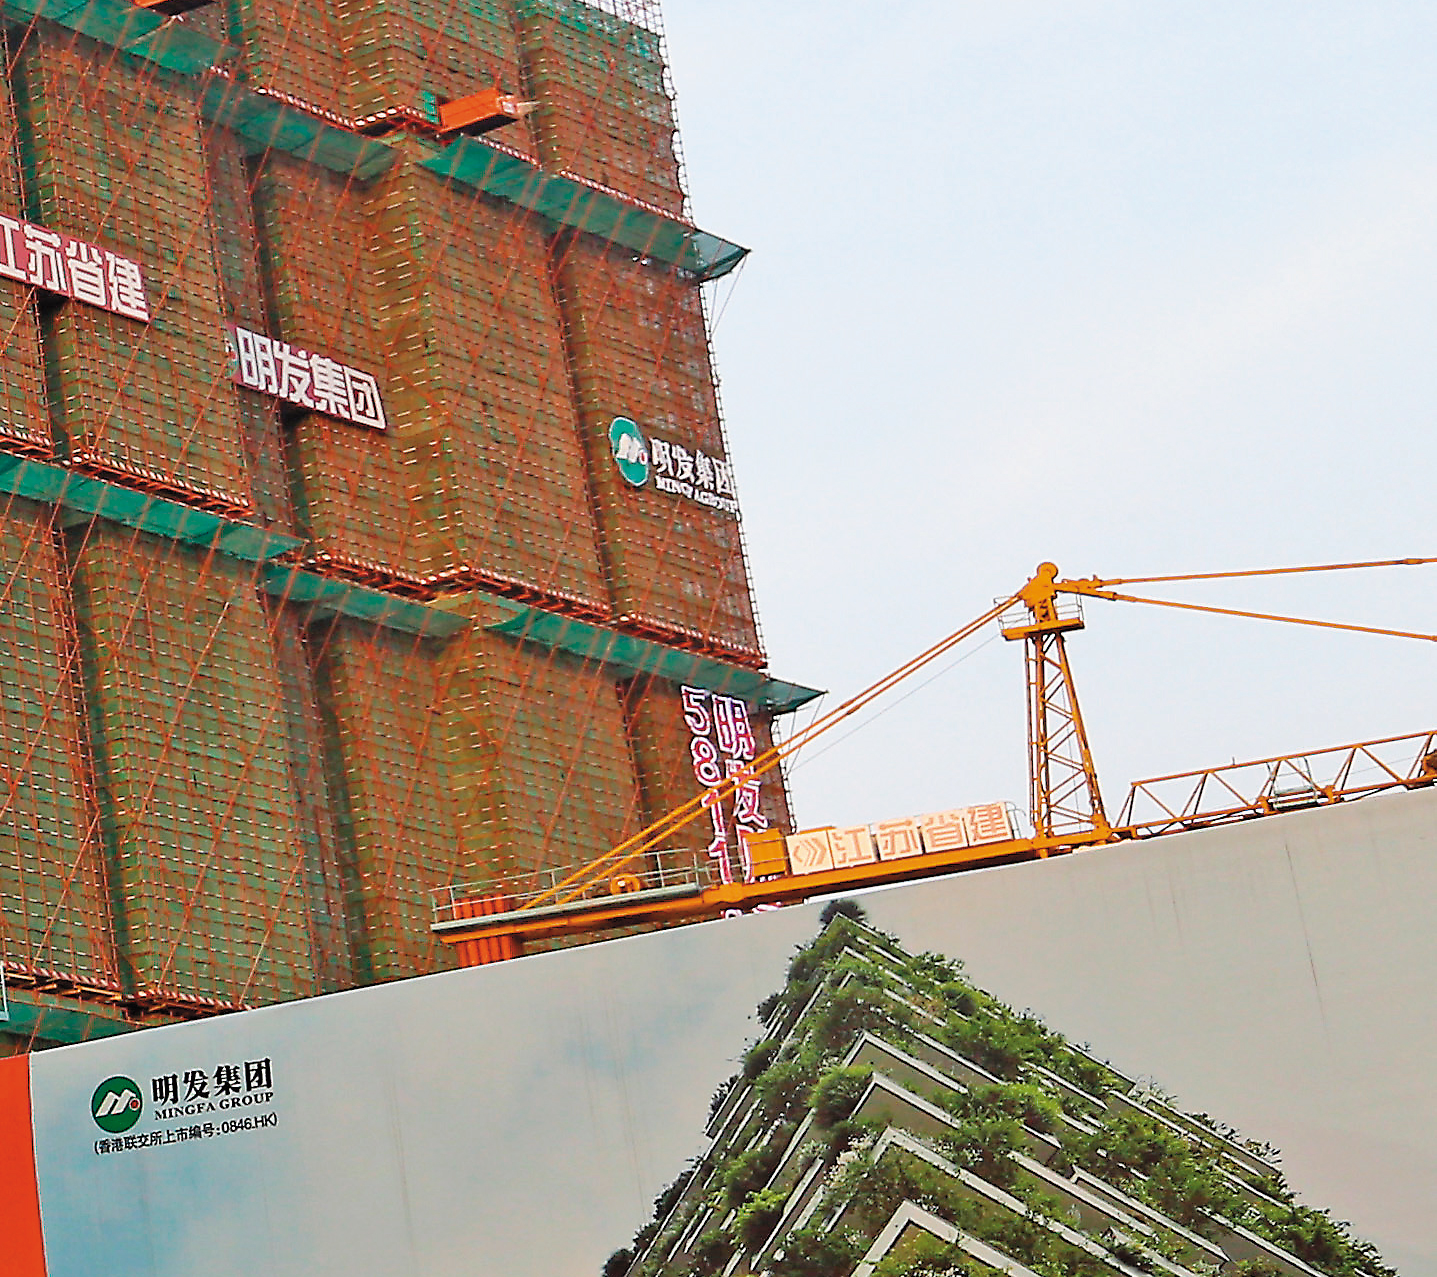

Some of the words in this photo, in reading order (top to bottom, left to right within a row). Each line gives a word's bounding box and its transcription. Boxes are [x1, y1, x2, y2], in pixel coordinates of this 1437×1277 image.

[235, 326, 386, 430] 明发集团
[831, 803, 1009, 865] 江苏省建
[150, 1057, 273, 1106] 明发集团
[154, 1099, 216, 1121] MINGFA
[219, 1091, 274, 1110] GROUP
